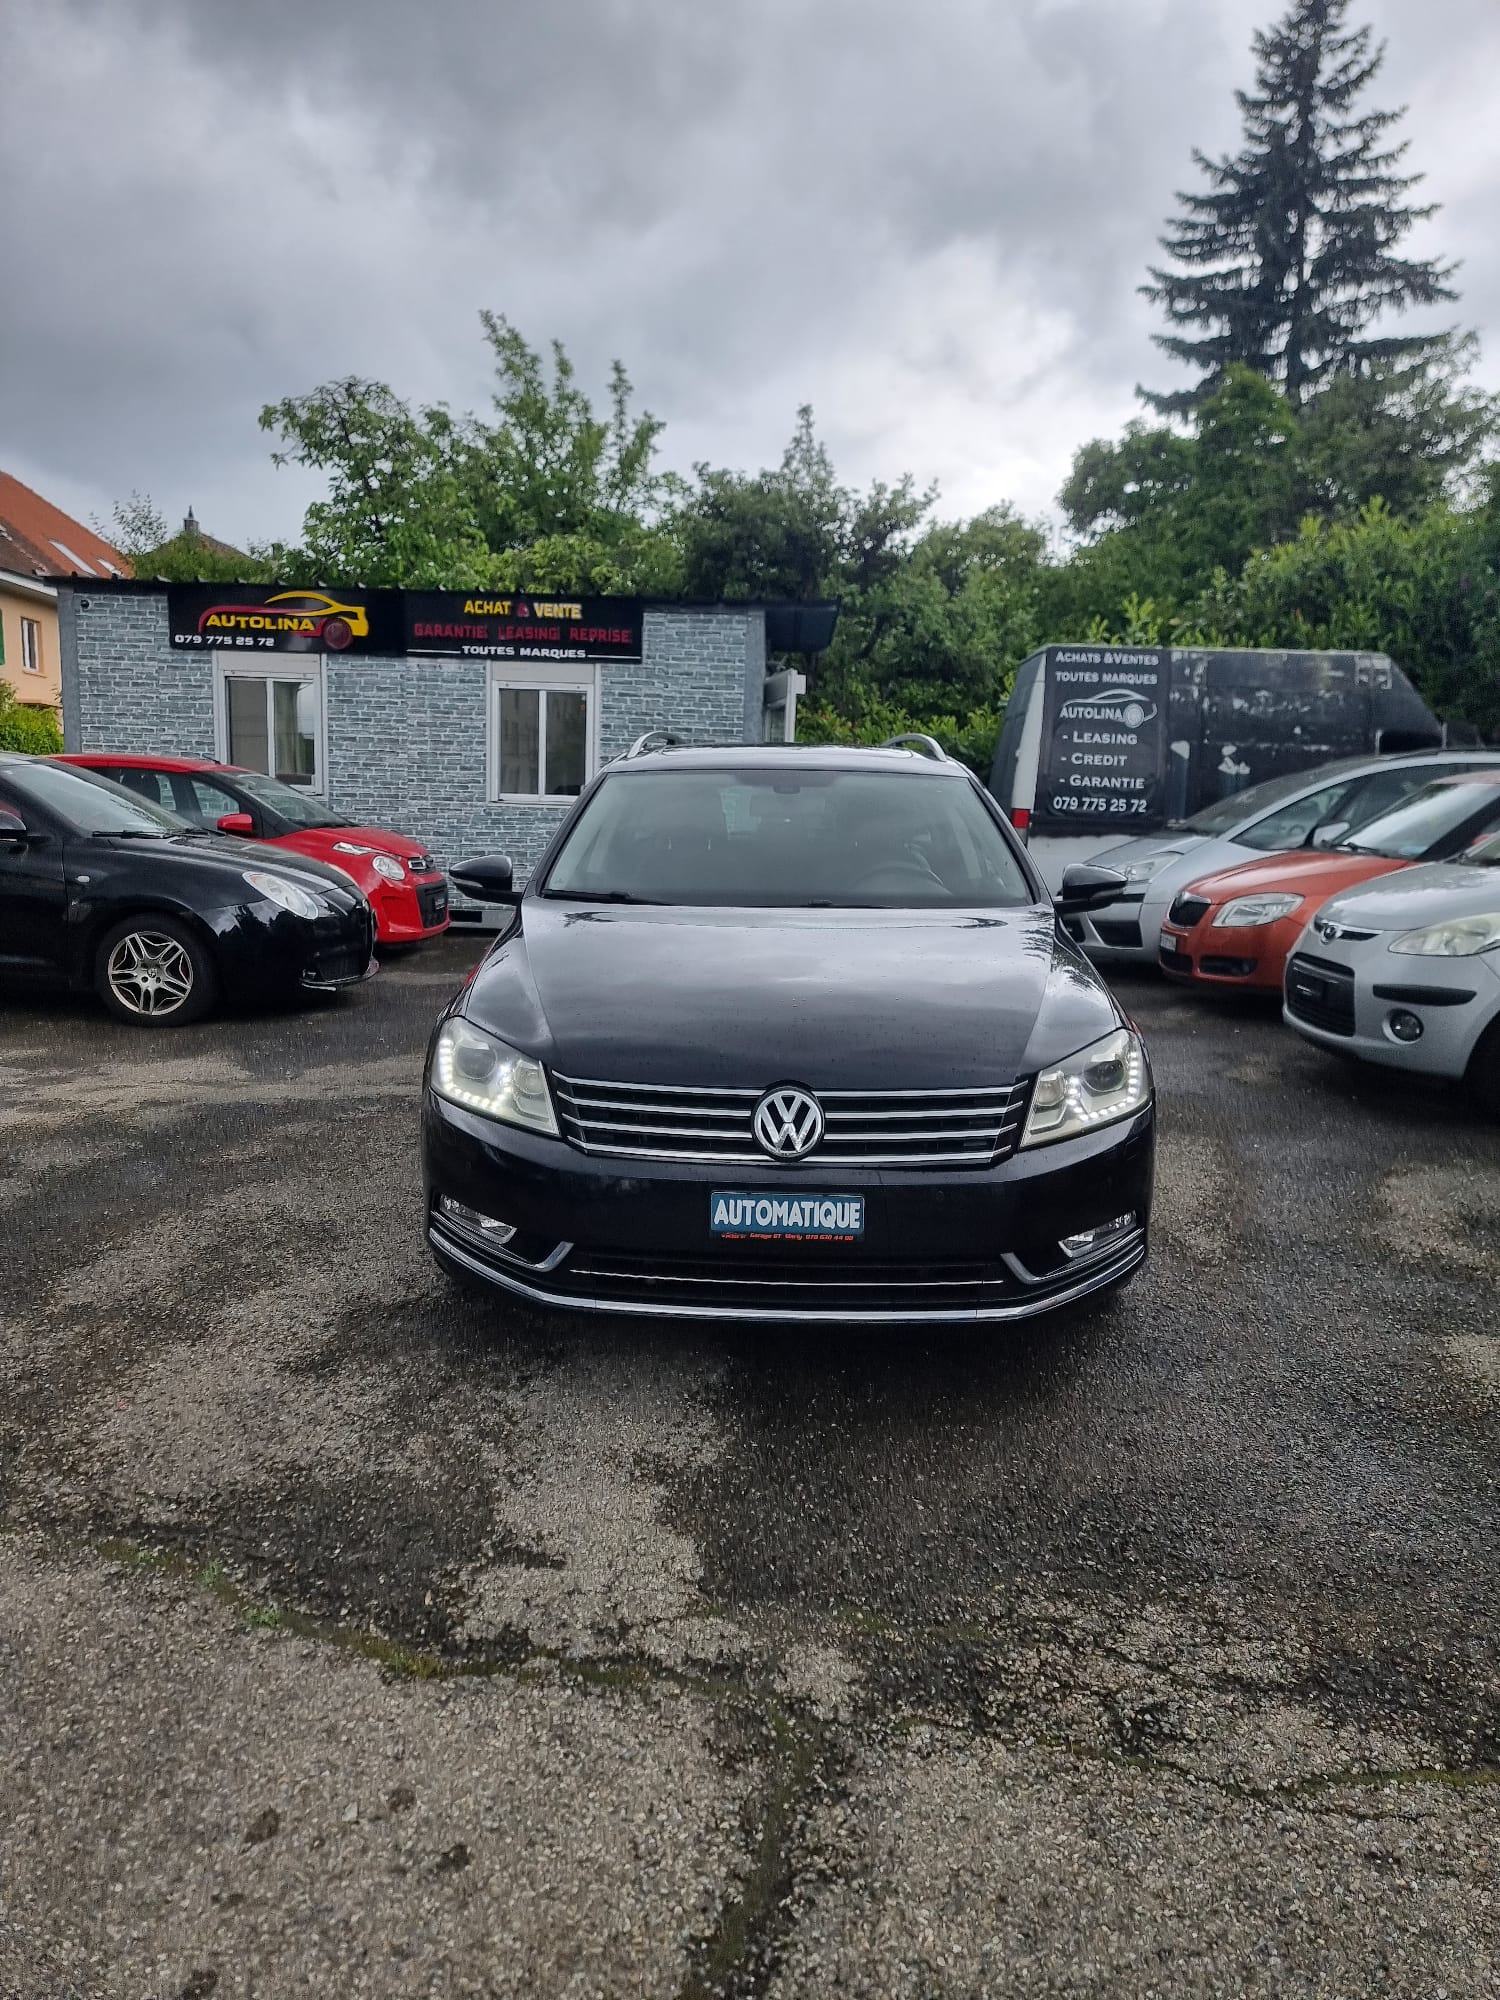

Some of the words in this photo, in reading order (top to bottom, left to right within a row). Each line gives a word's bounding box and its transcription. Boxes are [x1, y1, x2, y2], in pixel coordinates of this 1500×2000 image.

[464, 600, 511, 615] ACHAT
[533, 603, 582, 619] VENTE
[207, 614, 315, 631] AUTOLINA
[414, 623, 487, 639] GARANTIE
[498, 626, 559, 640] LEASING
[569, 628, 631, 643] REPRISE
[175, 635, 201, 644] 079
[206, 636, 232, 645] 775
[236, 637, 253, 646] 25
[257, 638, 274, 647] 72
[462, 645, 514, 656] TOUTES
[520, 648, 586, 659] MARQUES
[1056, 671, 1099, 683] TOUTES
[1102, 673, 1158, 685] MARQUES
[1059, 707, 1123, 720] AUTOLINA
[1073, 731, 1138, 745] LEASING
[1071, 753, 1127, 766] CREDIT
[1070, 774, 1145, 789] GARANTIE
[1053, 797, 1079, 810] 079
[1082, 798, 1107, 811] 775
[1110, 799, 1127, 812] 25
[1131, 800, 1147, 813] 72
[714, 1199, 861, 1229] AUTOMATIQUE
